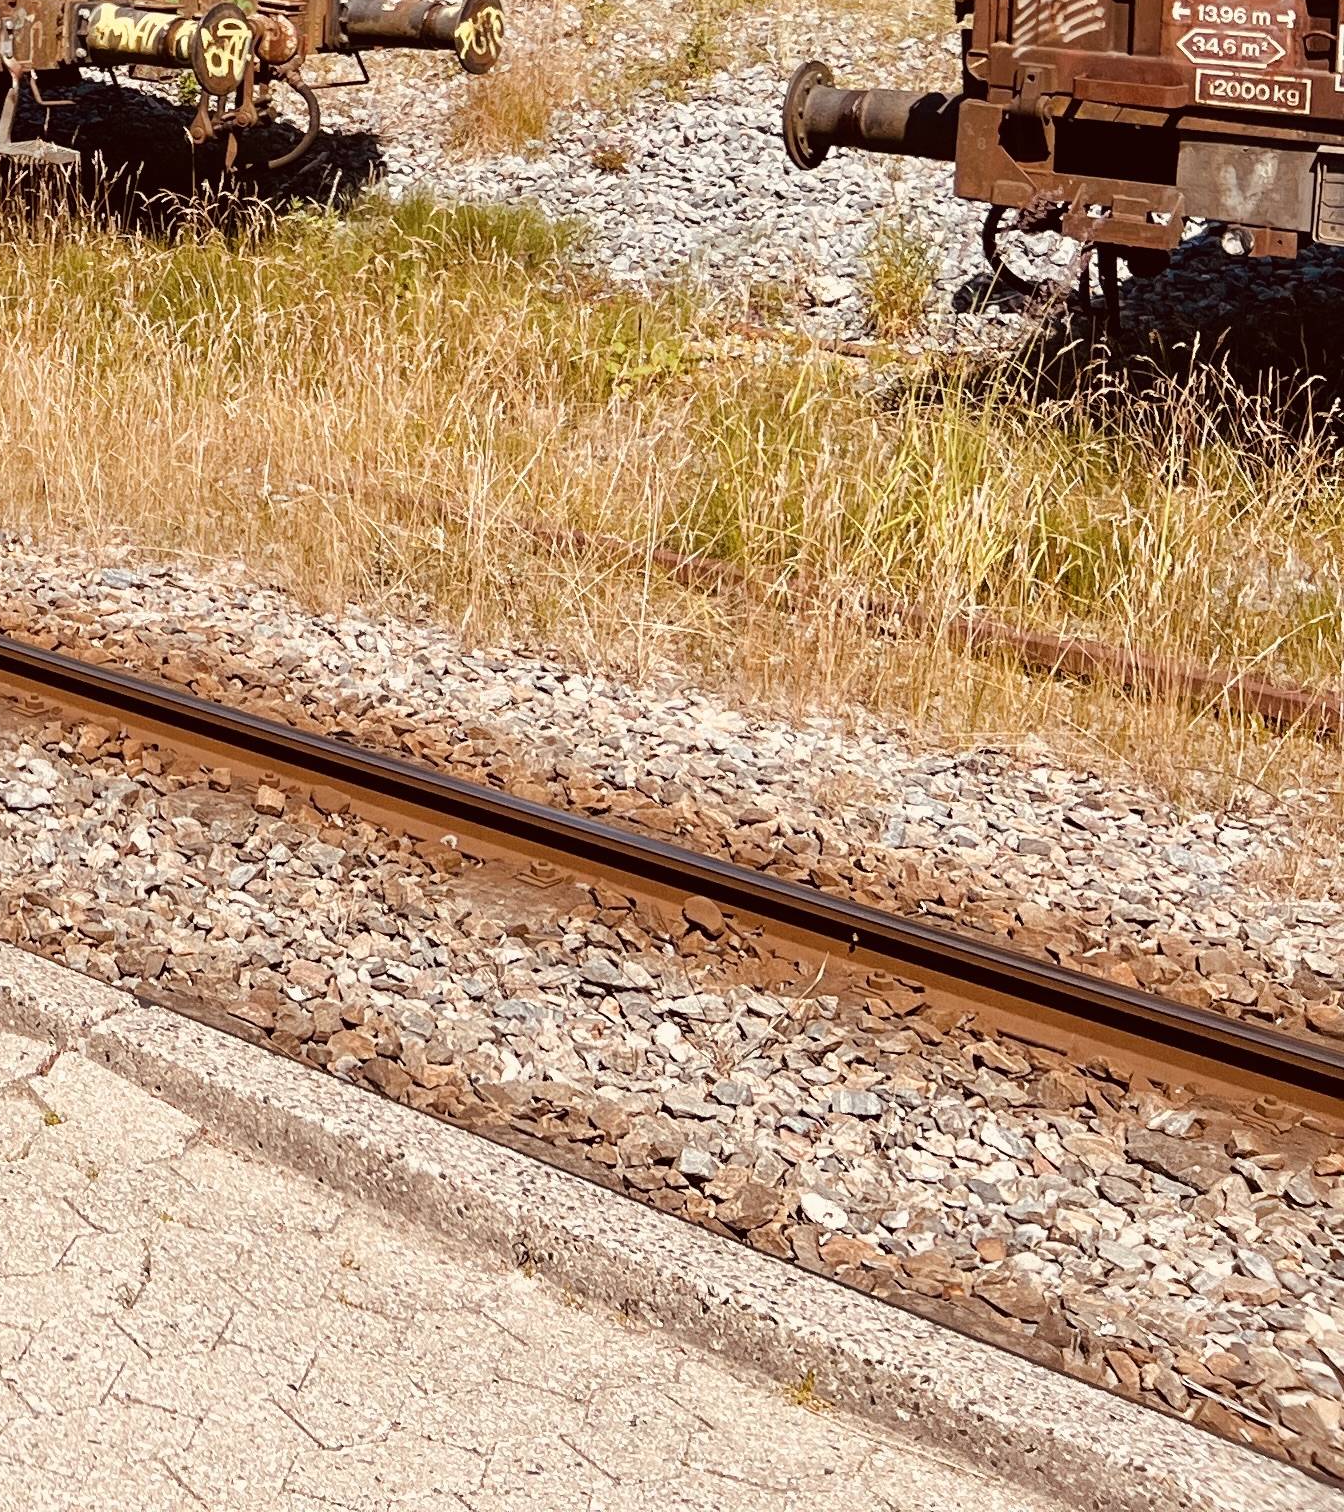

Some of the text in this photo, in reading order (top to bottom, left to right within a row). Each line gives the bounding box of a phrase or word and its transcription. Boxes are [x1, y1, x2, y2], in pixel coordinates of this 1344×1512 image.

[1197, 3, 1271, 26] 13,96 m
[1192, 36, 1237, 57] 34,6
[1208, 79, 1300, 107] 12000 kg
